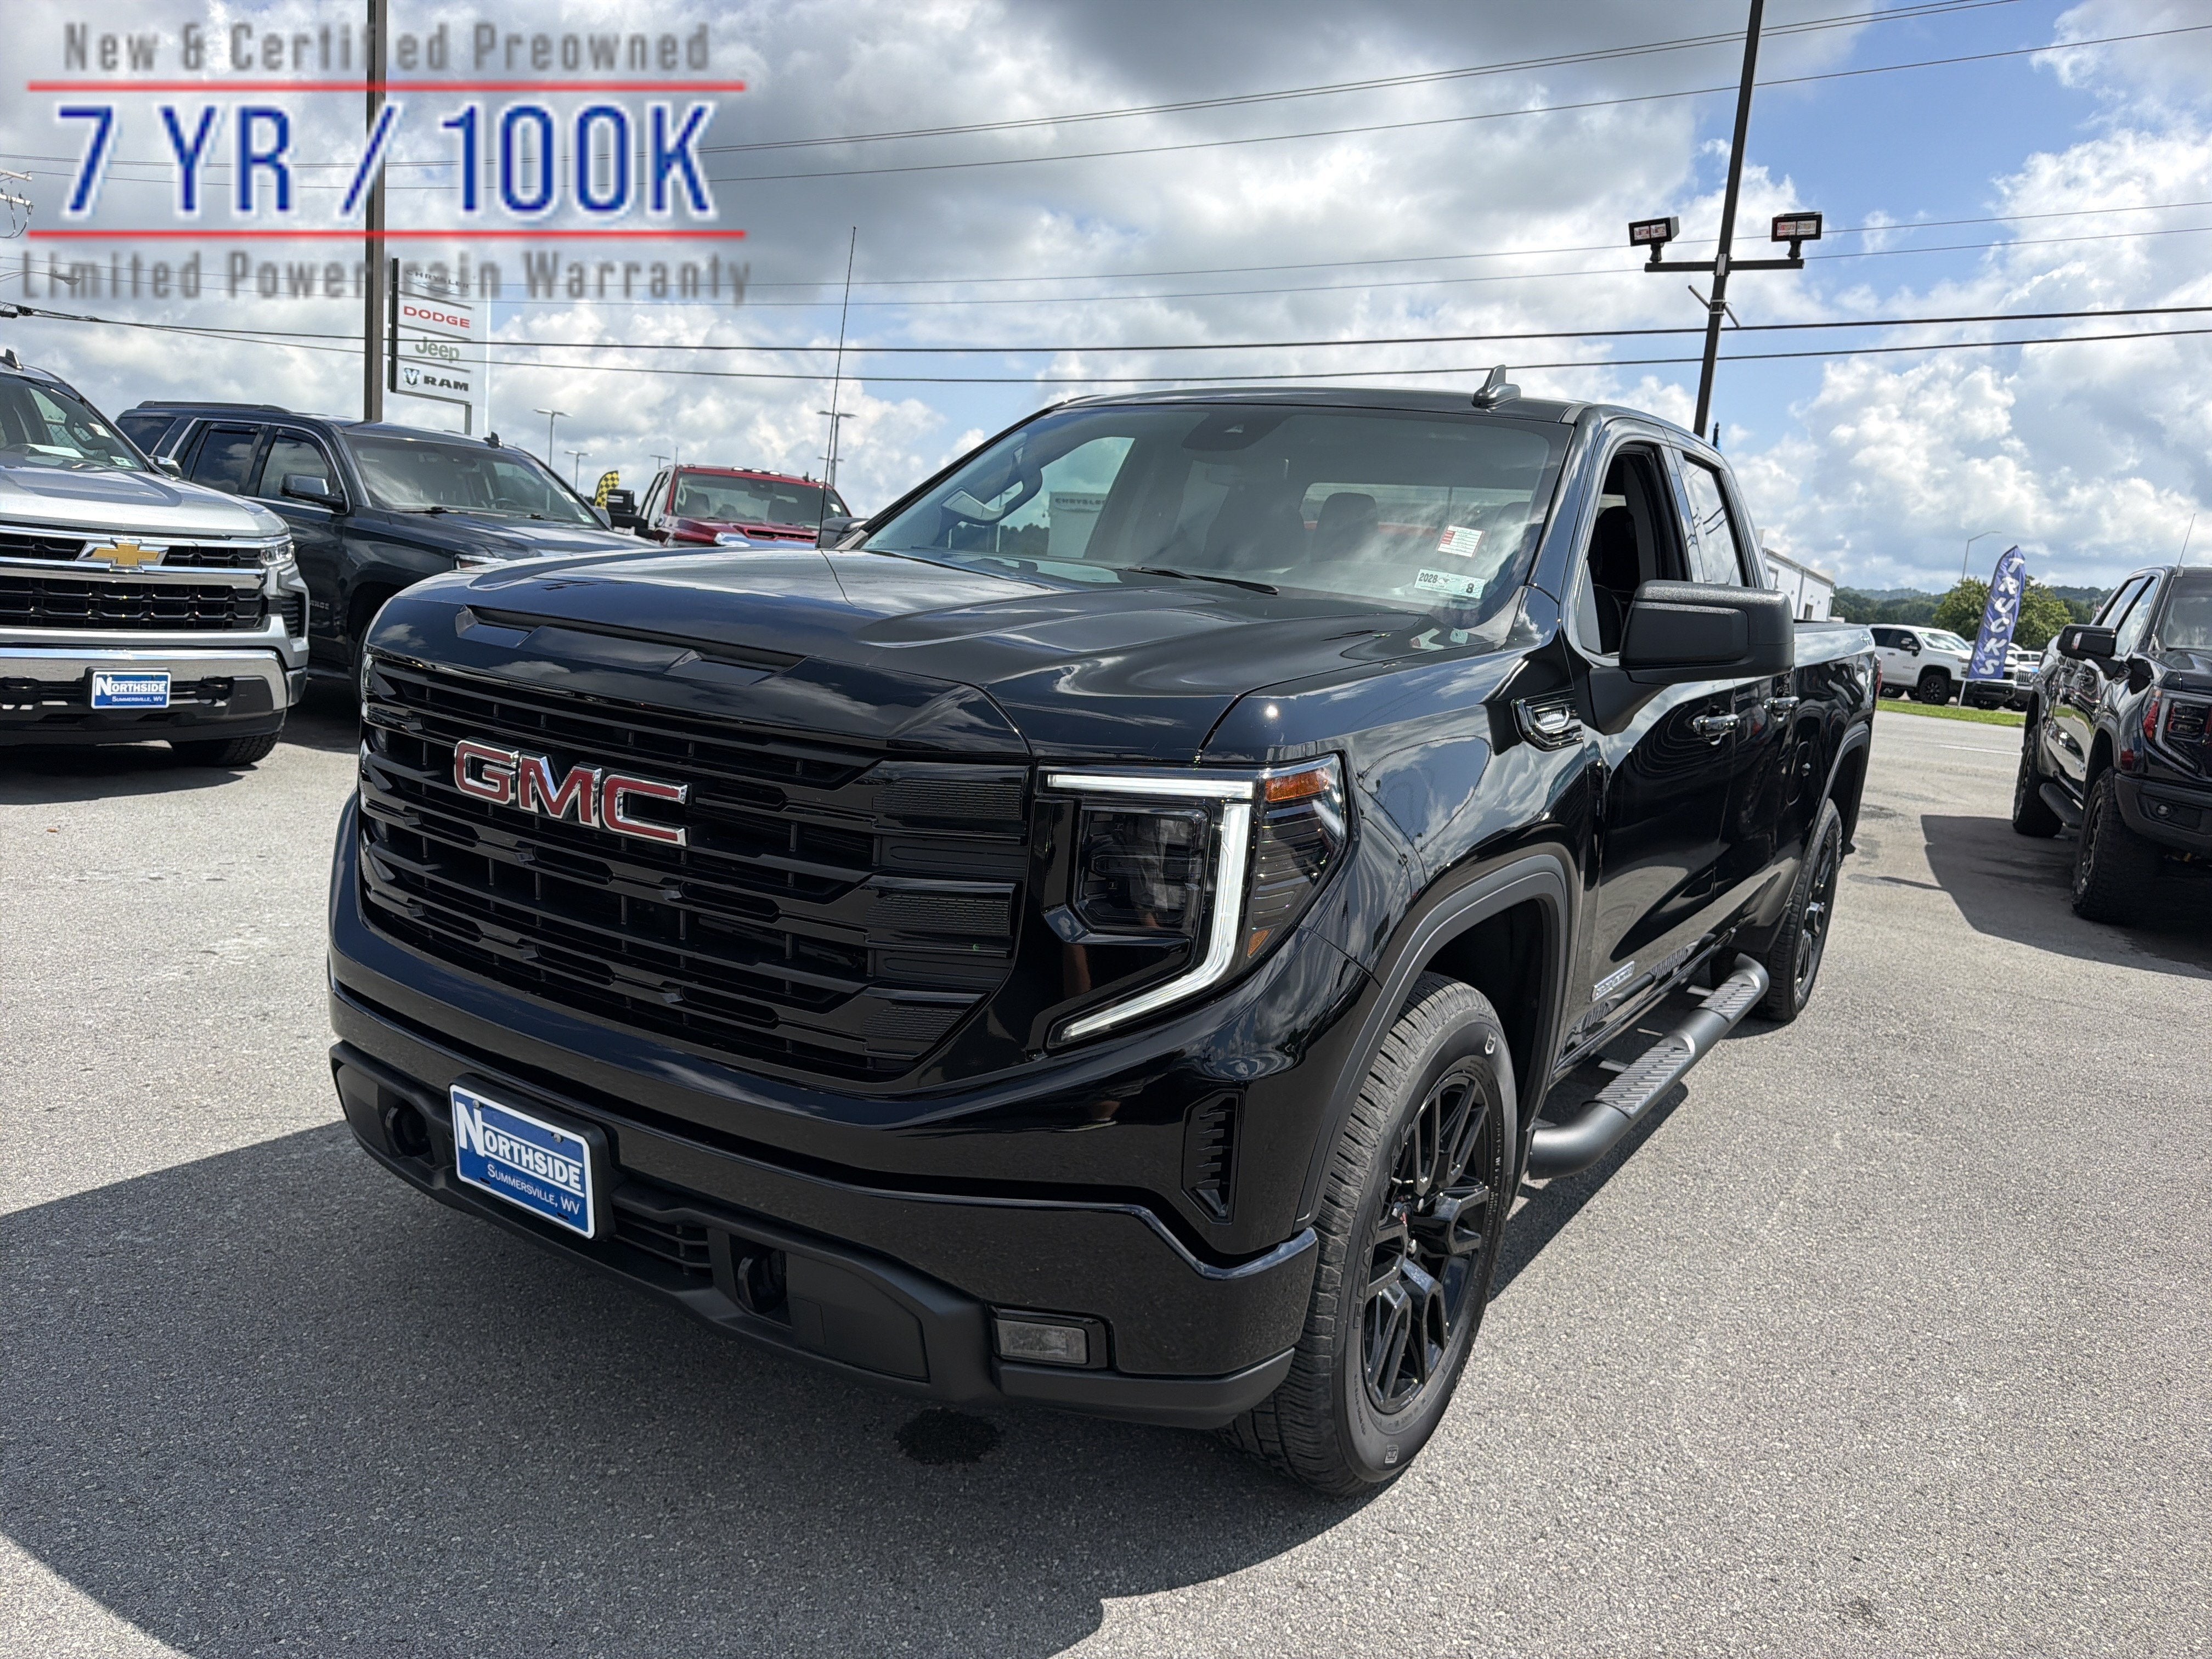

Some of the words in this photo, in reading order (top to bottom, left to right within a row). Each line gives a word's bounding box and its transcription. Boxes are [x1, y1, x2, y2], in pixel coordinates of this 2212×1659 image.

[404, 305, 471, 329] DODGE
[415, 336, 460, 363] Jeep
[424, 375, 469, 392] RAM
[1418, 572, 1438, 584] 2028
[1466, 583, 1475, 594] 8
[1979, 557, 2024, 675] TRUCKS
[95, 676, 166, 696] NORTHSIDE
[454, 740, 689, 847] GMC
[455, 1101, 582, 1190] NORTHSIDE
[487, 1163, 558, 1207] SUMMERSVILLE,
[561, 1196, 580, 1215] WV
